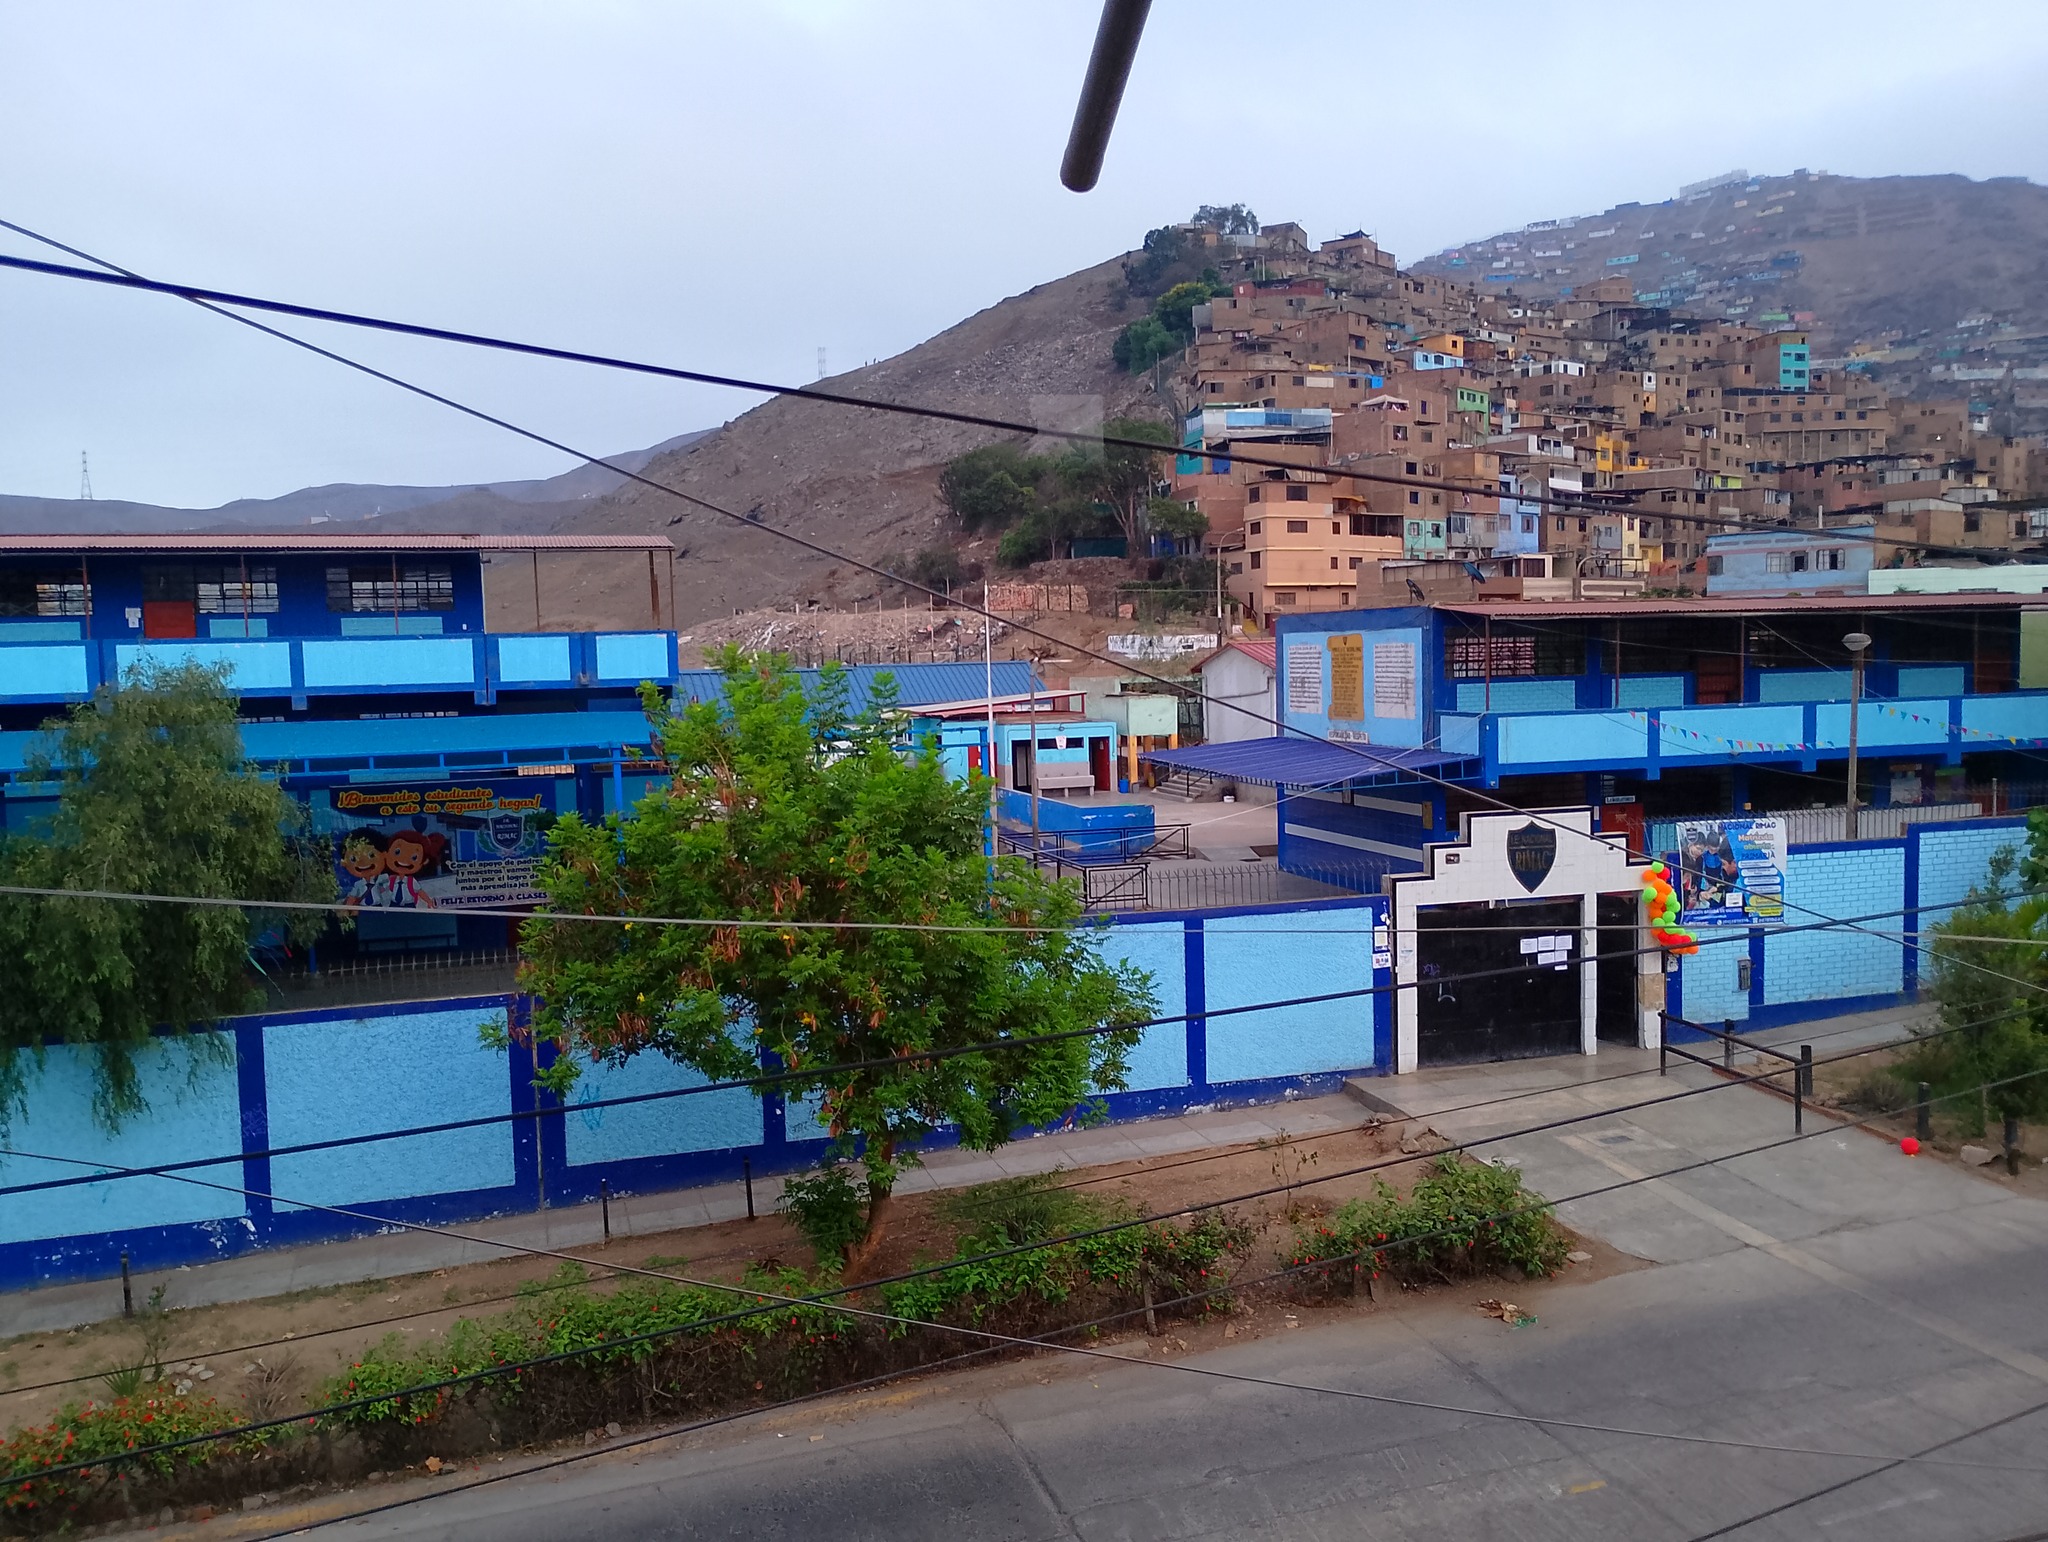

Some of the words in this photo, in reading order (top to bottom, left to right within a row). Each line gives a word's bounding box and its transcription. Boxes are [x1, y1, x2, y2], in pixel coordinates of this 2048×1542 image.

[425, 787, 493, 801] estudiantes
[396, 802, 420, 814] este
[424, 803, 441, 813] su
[444, 798, 496, 815] segundo
[498, 794, 542, 812] hogar!
[467, 867, 503, 875] maestros
[467, 894, 505, 903] RETORNO
[516, 891, 548, 900] CLASES
